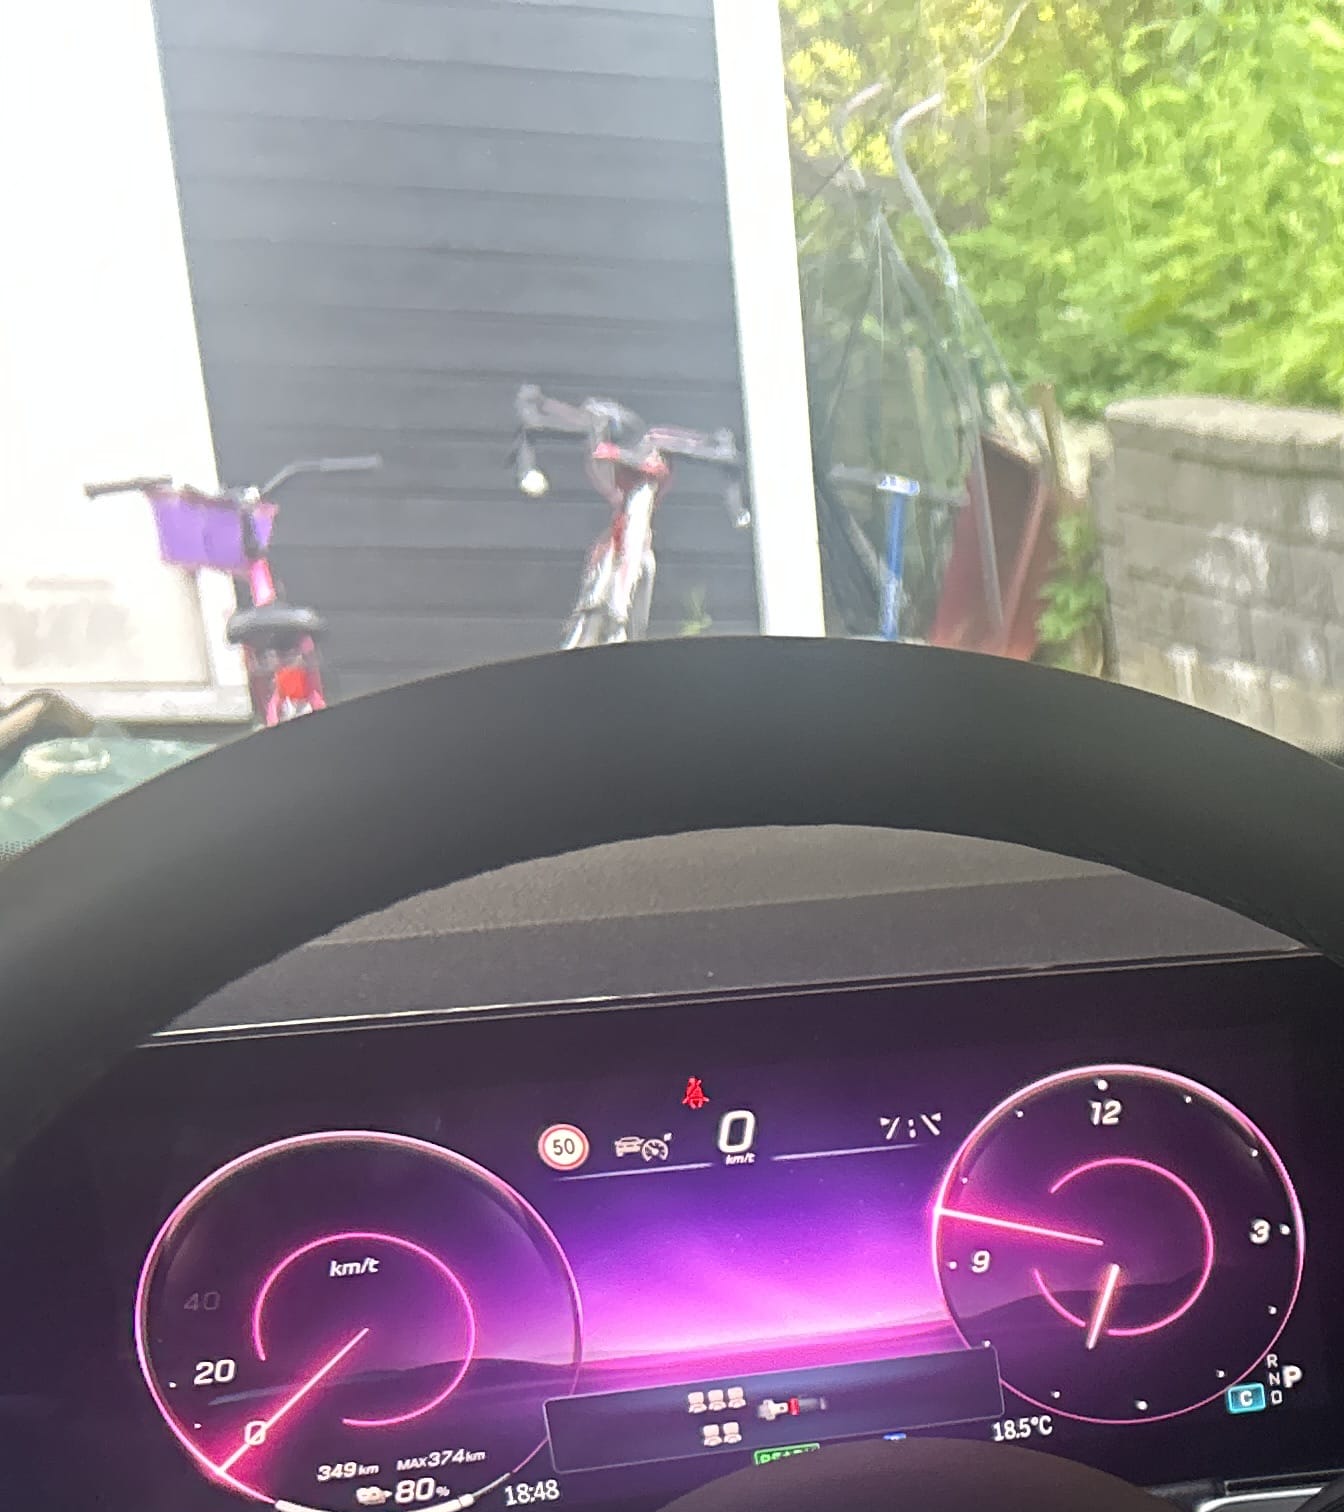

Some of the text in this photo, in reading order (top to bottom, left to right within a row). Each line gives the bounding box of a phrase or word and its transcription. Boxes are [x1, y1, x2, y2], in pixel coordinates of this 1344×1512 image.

[1091, 1100, 1122, 1126] 12
[718, 1109, 756, 1154] 0
[552, 1137, 576, 1156] 50
[725, 1152, 756, 1165] km/t
[1250, 1219, 1271, 1244] 3
[329, 1257, 380, 1277] km/t
[971, 1250, 991, 1274] 9
[193, 1359, 236, 1385] 20
[1266, 1353, 1279, 1369] R
[1268, 1371, 1281, 1387] N
[1282, 1365, 1302, 1388] P
[244, 1419, 267, 1445] 0
[504, 1480, 560, 1507] 18:48
